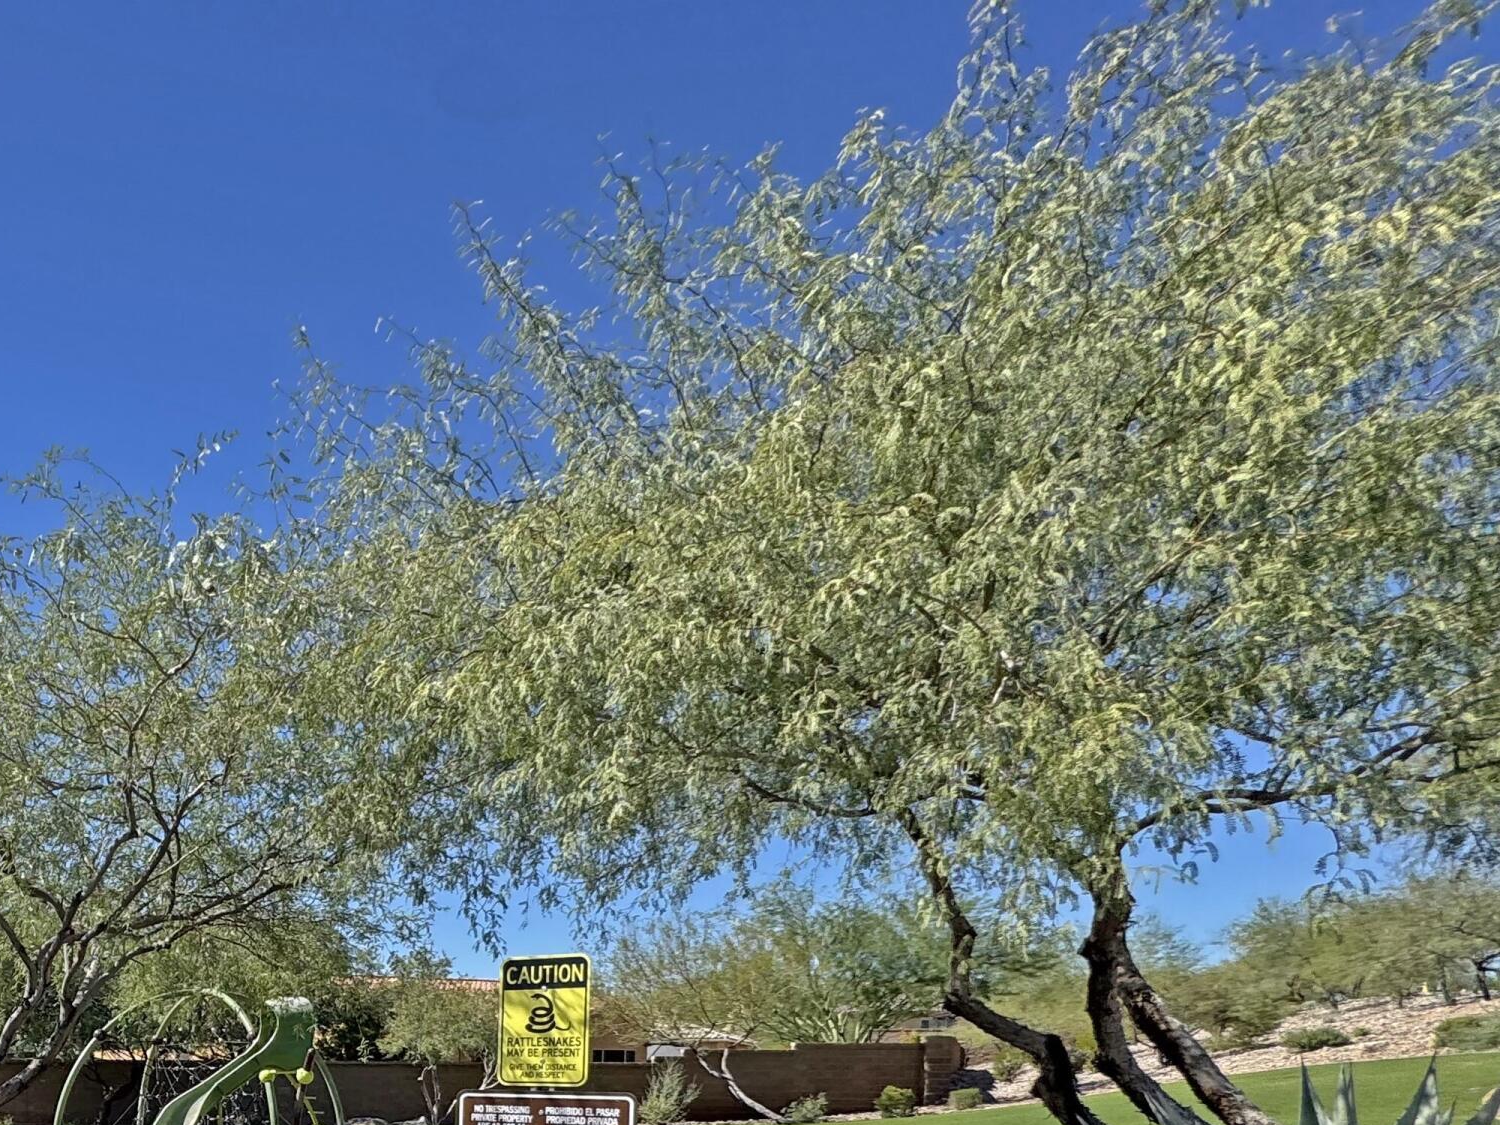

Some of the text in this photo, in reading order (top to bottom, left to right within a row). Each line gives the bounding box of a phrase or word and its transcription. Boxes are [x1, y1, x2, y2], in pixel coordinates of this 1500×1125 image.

[506, 963, 585, 985] CAUTION
[506, 1036, 582, 1047] RATTLESNAKES
[506, 1048, 581, 1057] MAY BE PRESENT
[545, 1063, 577, 1071] DISTANCE
[535, 1071, 565, 1079] RESPECT
[473, 1105, 531, 1114] NO TRESPASSING
[544, 1106, 621, 1118] PROHIBIDO EL PASAR
[470, 1113, 534, 1124] PRIVATE PROPERTY
[545, 1115, 586, 1125] PROPIEDAD
